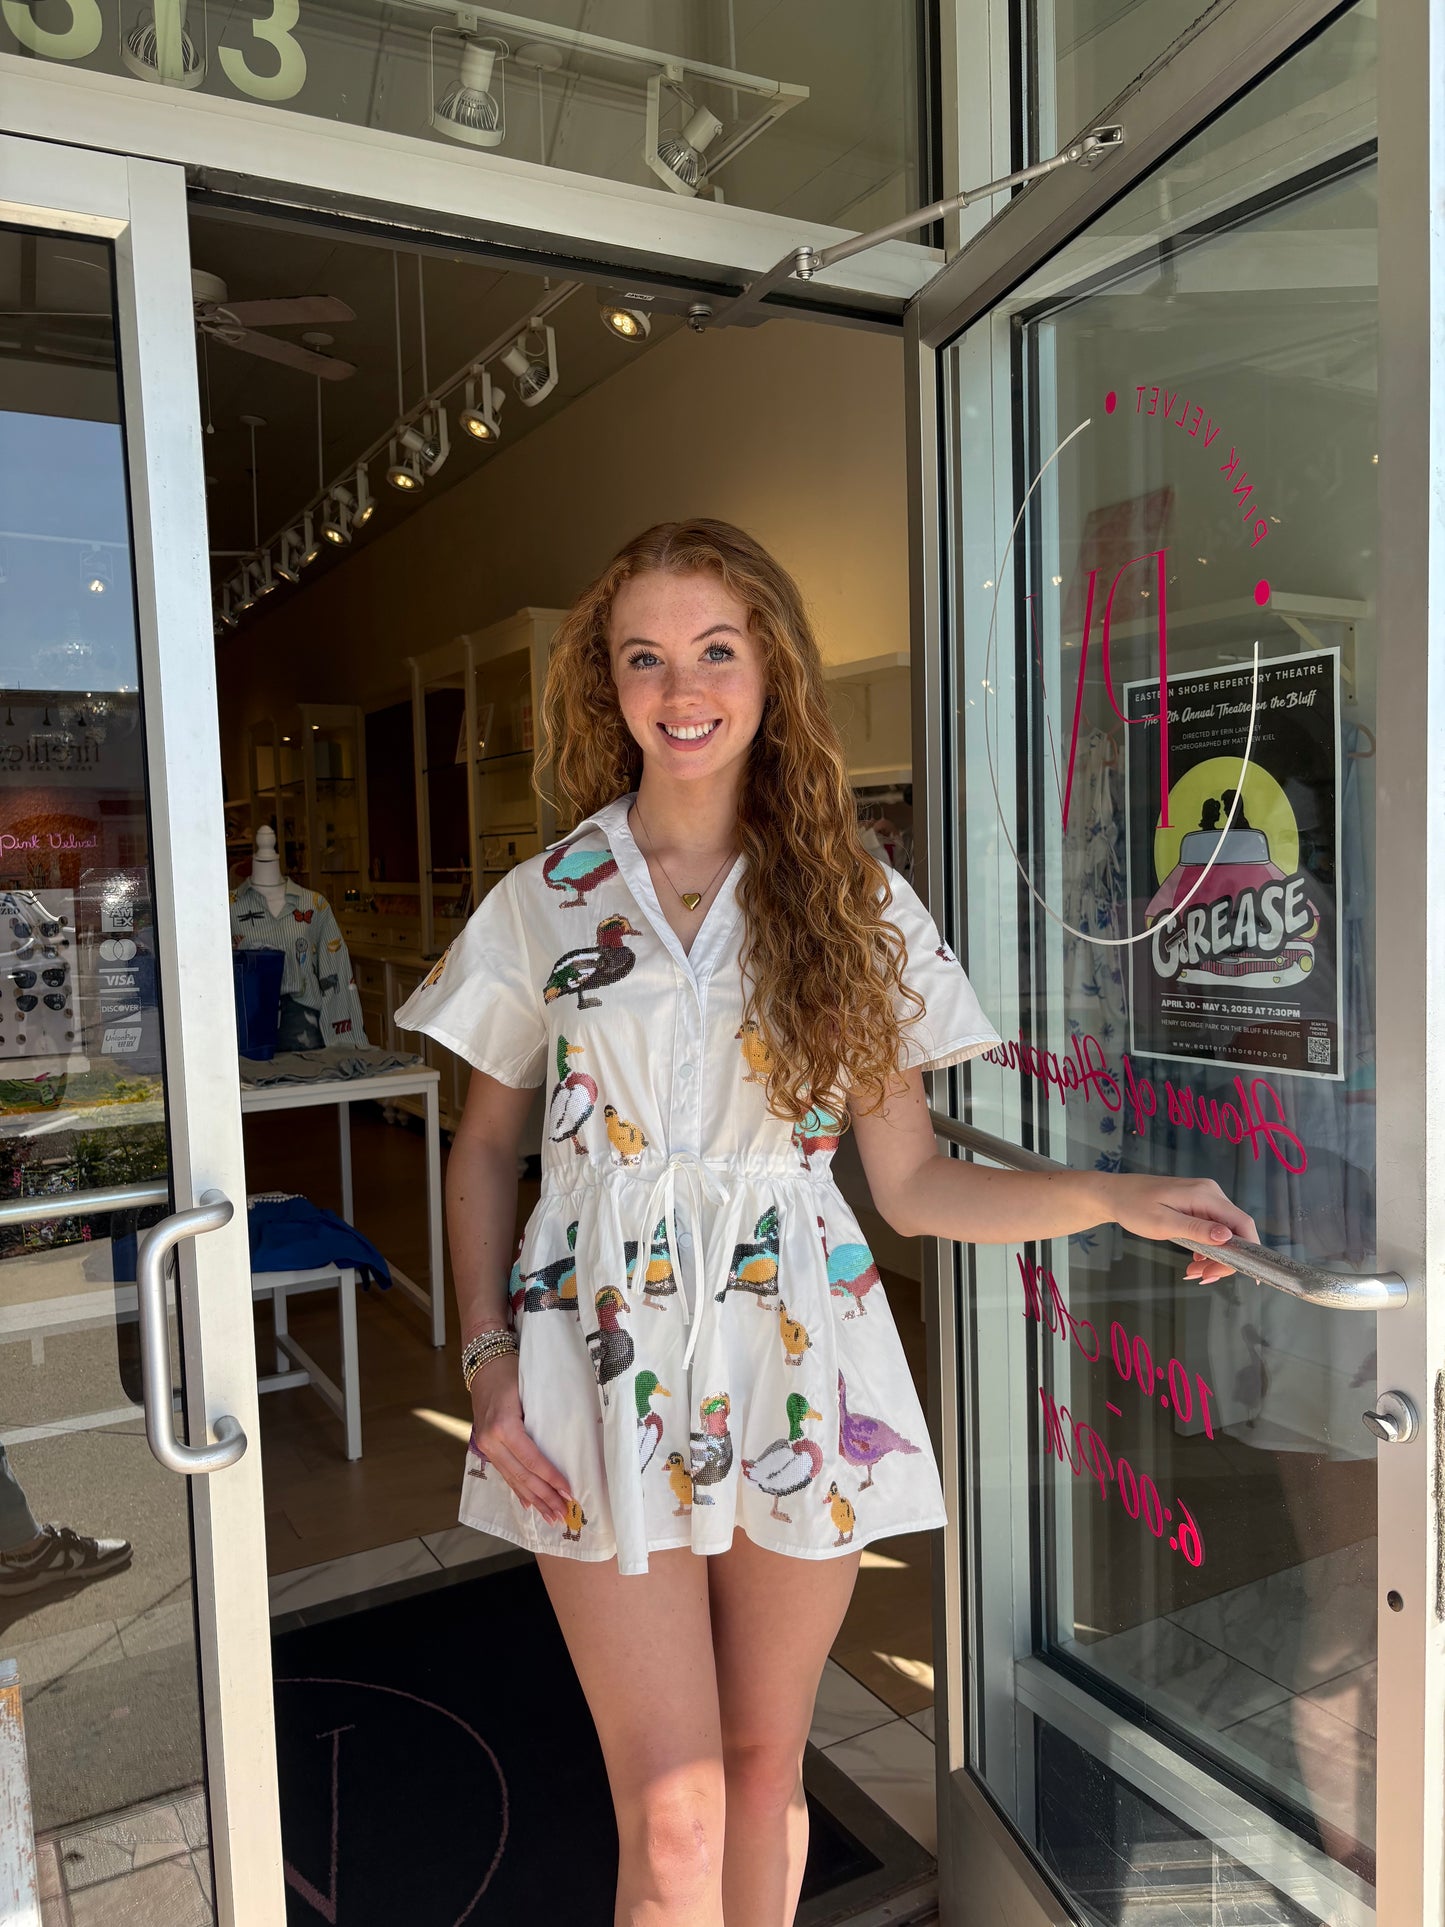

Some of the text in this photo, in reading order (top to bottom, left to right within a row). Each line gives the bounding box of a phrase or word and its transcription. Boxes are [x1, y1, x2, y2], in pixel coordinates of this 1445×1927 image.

[1135, 664, 1324, 702] EASTEN SHORE REPERTORY THEATRE
[1181, 704, 1215, 723] Annual
[1216, 699, 1251, 719] Theatre
[1254, 698, 1268, 710] on
[1270, 693, 1285, 708] the
[1286, 688, 1317, 709] Bluff
[1171, 740, 1221, 752] CHOREOGRAPHED
[1232, 735, 1261, 744] MATTEW
[1262, 733, 1275, 741] KIEL
[1182, 729, 1210, 740] DIRECTED
[1211, 729, 1219, 737] BY
[1220, 727, 1234, 736] ERIN
[0, 832, 98, 857] Pink Velvet
[1152, 877, 1309, 978] GREASE
[104, 975, 135, 986] VISA
[101, 1004, 139, 1013] DISCOVER
[1161, 999, 1183, 1009] APRIL
[1185, 1001, 1196, 1009] 30
[1202, 1003, 1220, 1012] MAY
[1221, 1004, 1230, 1013] 3,
[1231, 1005, 1253, 1014] 2025
[1255, 1007, 1265, 1015] AT
[1267, 1008, 1300, 1018] 7:30PM
[105, 1034, 137, 1044] UnionPay
[1180, 1020, 1203, 1028] GEORGE
[1204, 1023, 1219, 1031] PARK
[1231, 1025, 1242, 1033] THE
[1243, 1026, 1261, 1034] BLUFF
[1270, 1029, 1300, 1039] FAIRHOPE
[1172, 1041, 1288, 1061] www.easternshorerep.org
